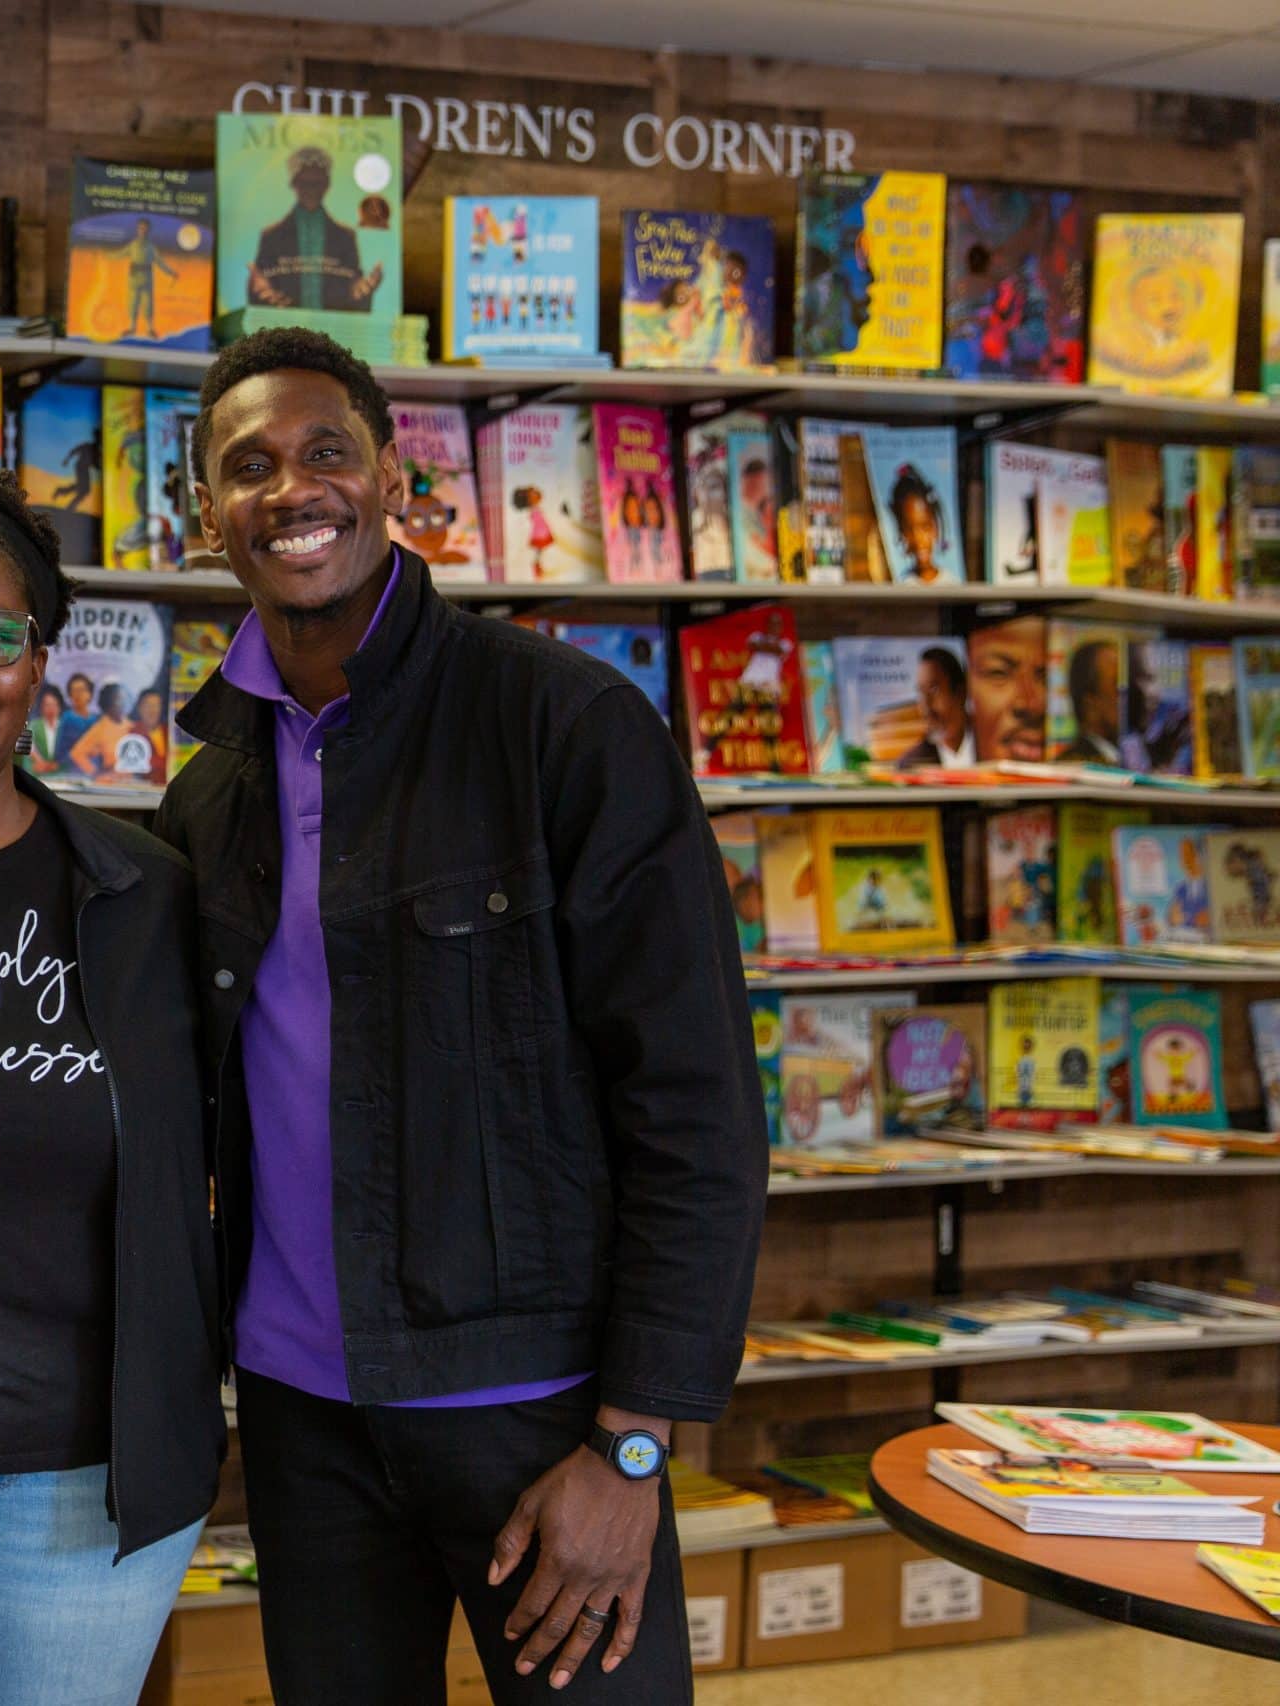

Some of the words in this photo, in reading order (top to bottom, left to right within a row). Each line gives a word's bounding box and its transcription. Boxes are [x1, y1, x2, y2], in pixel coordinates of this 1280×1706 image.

[623, 112, 856, 178] CORNER
[72, 607, 147, 633] IDDEN
[697, 708, 783, 737] GOOD
